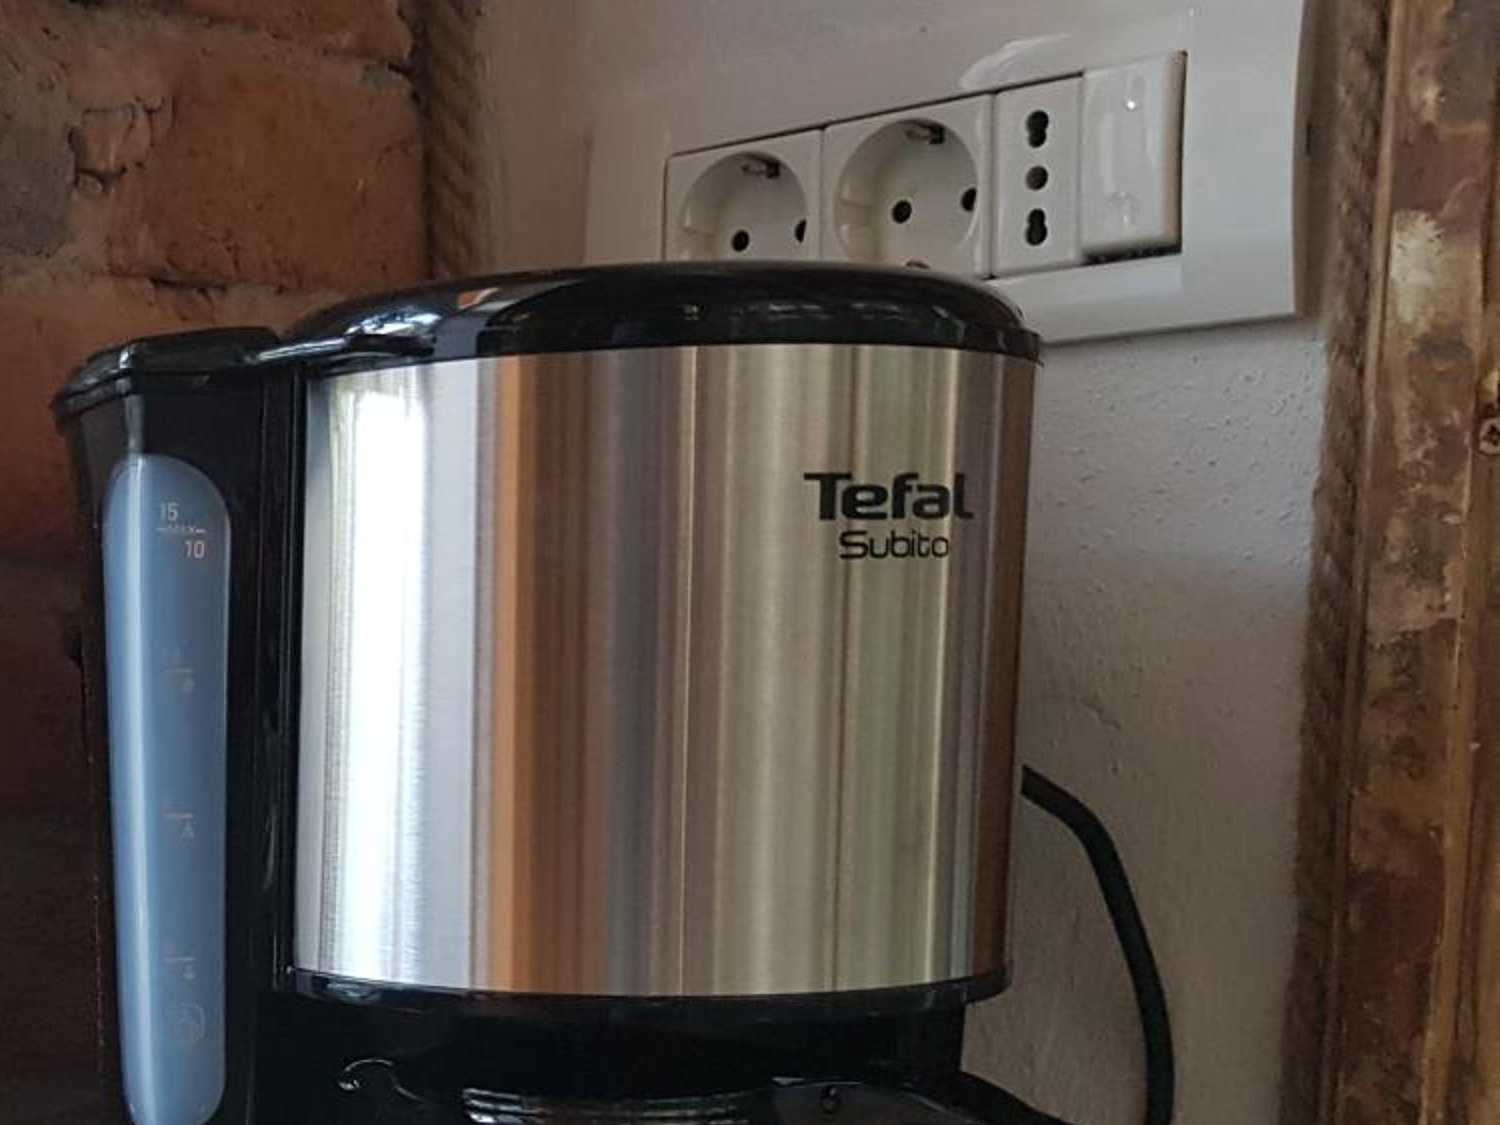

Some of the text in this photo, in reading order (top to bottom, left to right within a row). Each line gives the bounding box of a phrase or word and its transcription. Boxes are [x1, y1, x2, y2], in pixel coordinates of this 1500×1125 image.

[803, 472, 975, 521] Tefal
[160, 502, 179, 522] 15
[185, 539, 205, 559] 10
[838, 530, 949, 560] Subito
